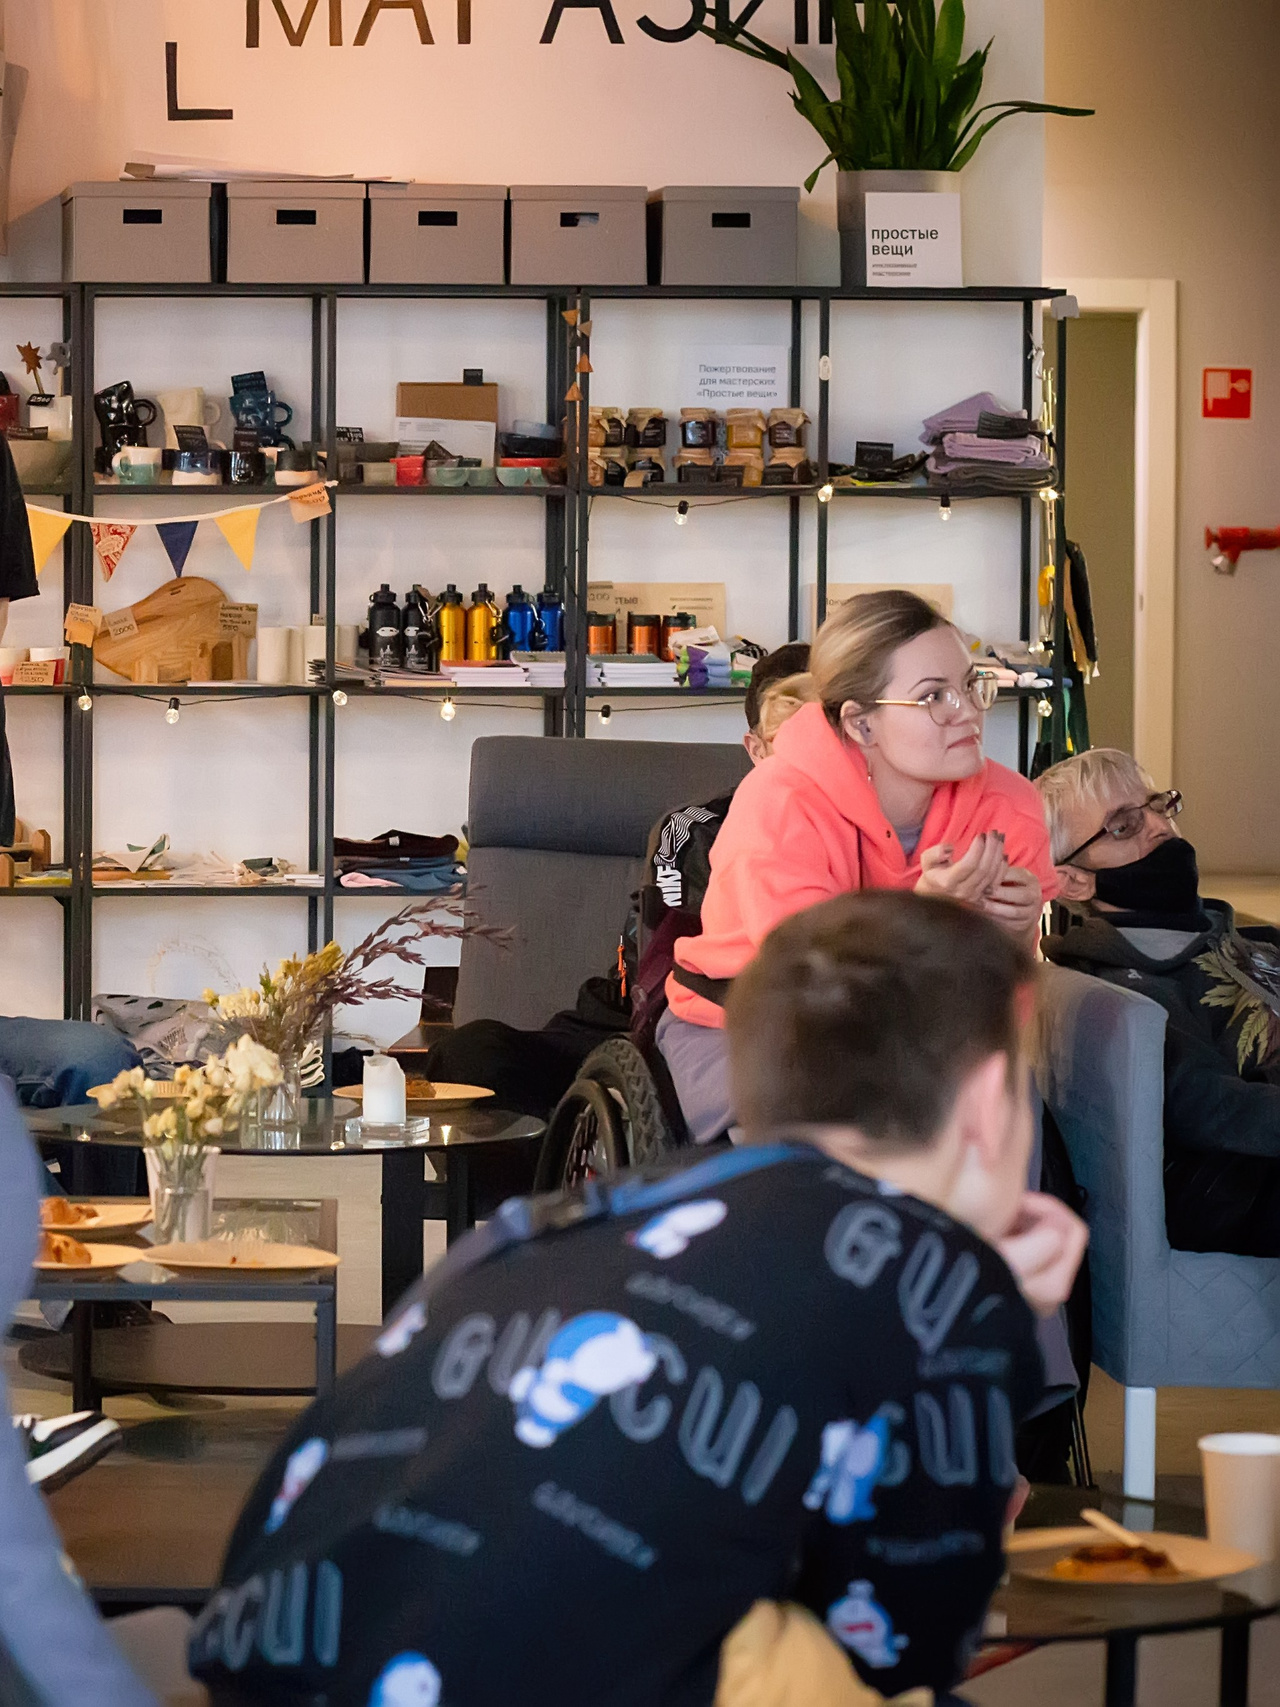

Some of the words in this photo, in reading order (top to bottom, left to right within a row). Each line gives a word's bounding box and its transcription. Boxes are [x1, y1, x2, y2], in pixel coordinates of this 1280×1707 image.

[871, 228, 939, 243] простые
[871, 244, 913, 257] вещи
[699, 364, 776, 375] Пожертвование
[699, 377, 717, 386] для
[719, 378, 776, 387] мастерских
[697, 388, 744, 399] «Простые
[746, 389, 777, 398] вещи»
